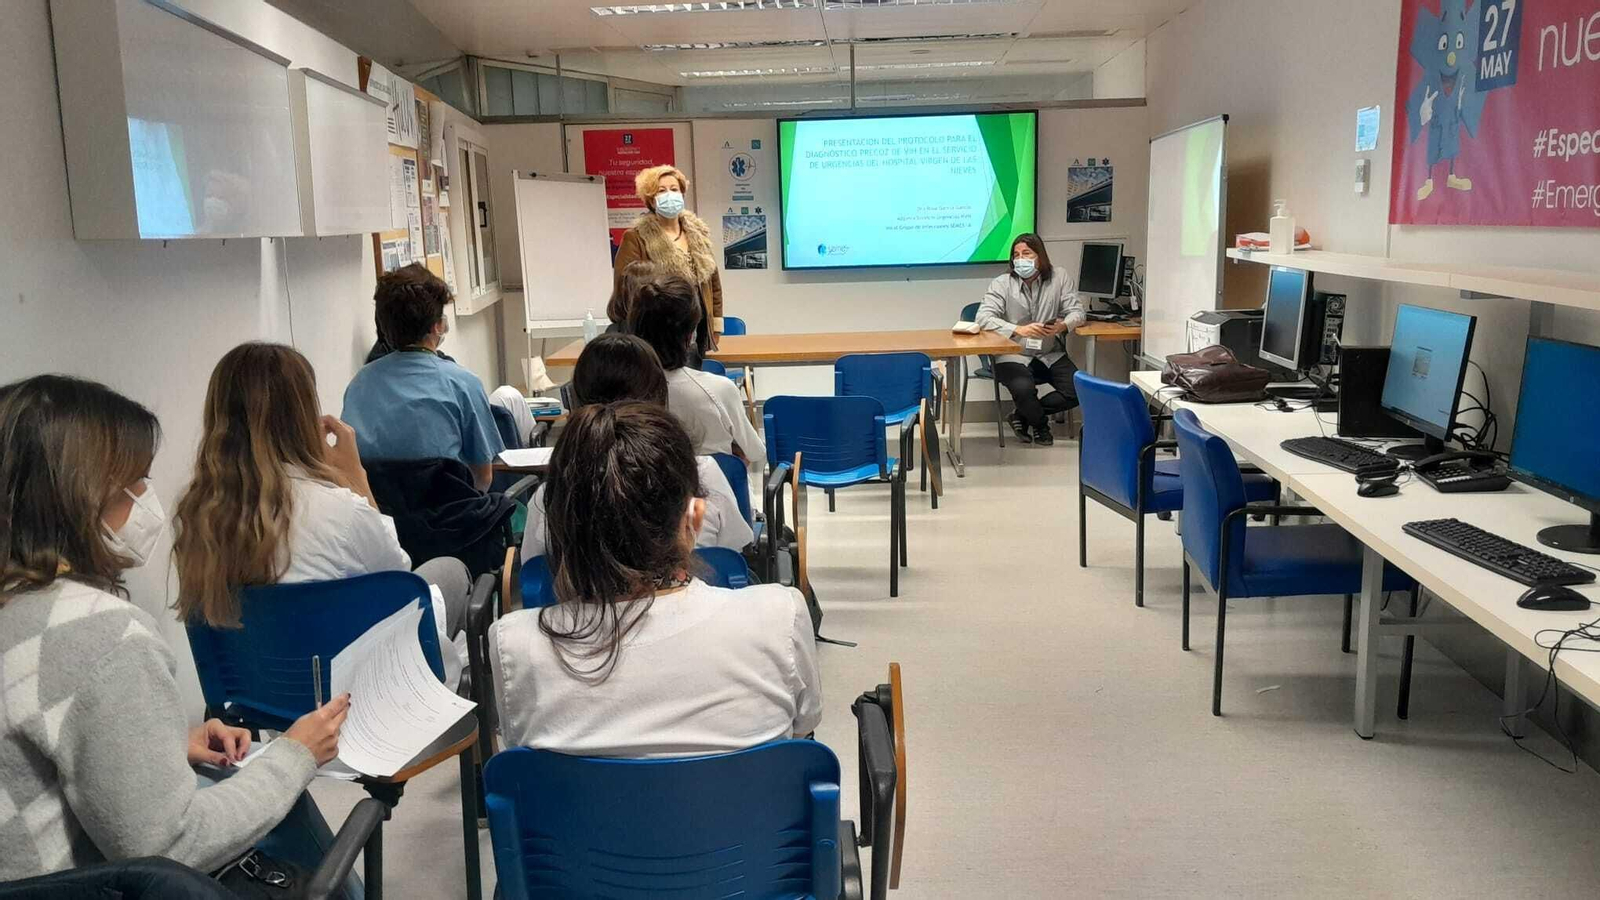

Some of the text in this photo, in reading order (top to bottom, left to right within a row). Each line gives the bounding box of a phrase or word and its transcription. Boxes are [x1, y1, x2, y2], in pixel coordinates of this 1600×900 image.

[1482, 0, 1516, 51] 27
[1480, 49, 1513, 80] MAY
[881, 136, 896, 146] DEL
[897, 135, 945, 145] PROTOCOLO
[946, 134, 966, 143] PARA
[967, 133, 977, 142] EL
[859, 148, 888, 157] PRECOZ
[891, 148, 900, 156] DE
[903, 147, 917, 156] VIH
[919, 146, 930, 155] EN
[931, 146, 940, 154] EL
[941, 144, 977, 154] SERVICIO
[808, 155, 977, 170] DE URGENCIAS DEL HOSPITAL VIRGEN DE LAS
[950, 166, 977, 175] NIEVES
